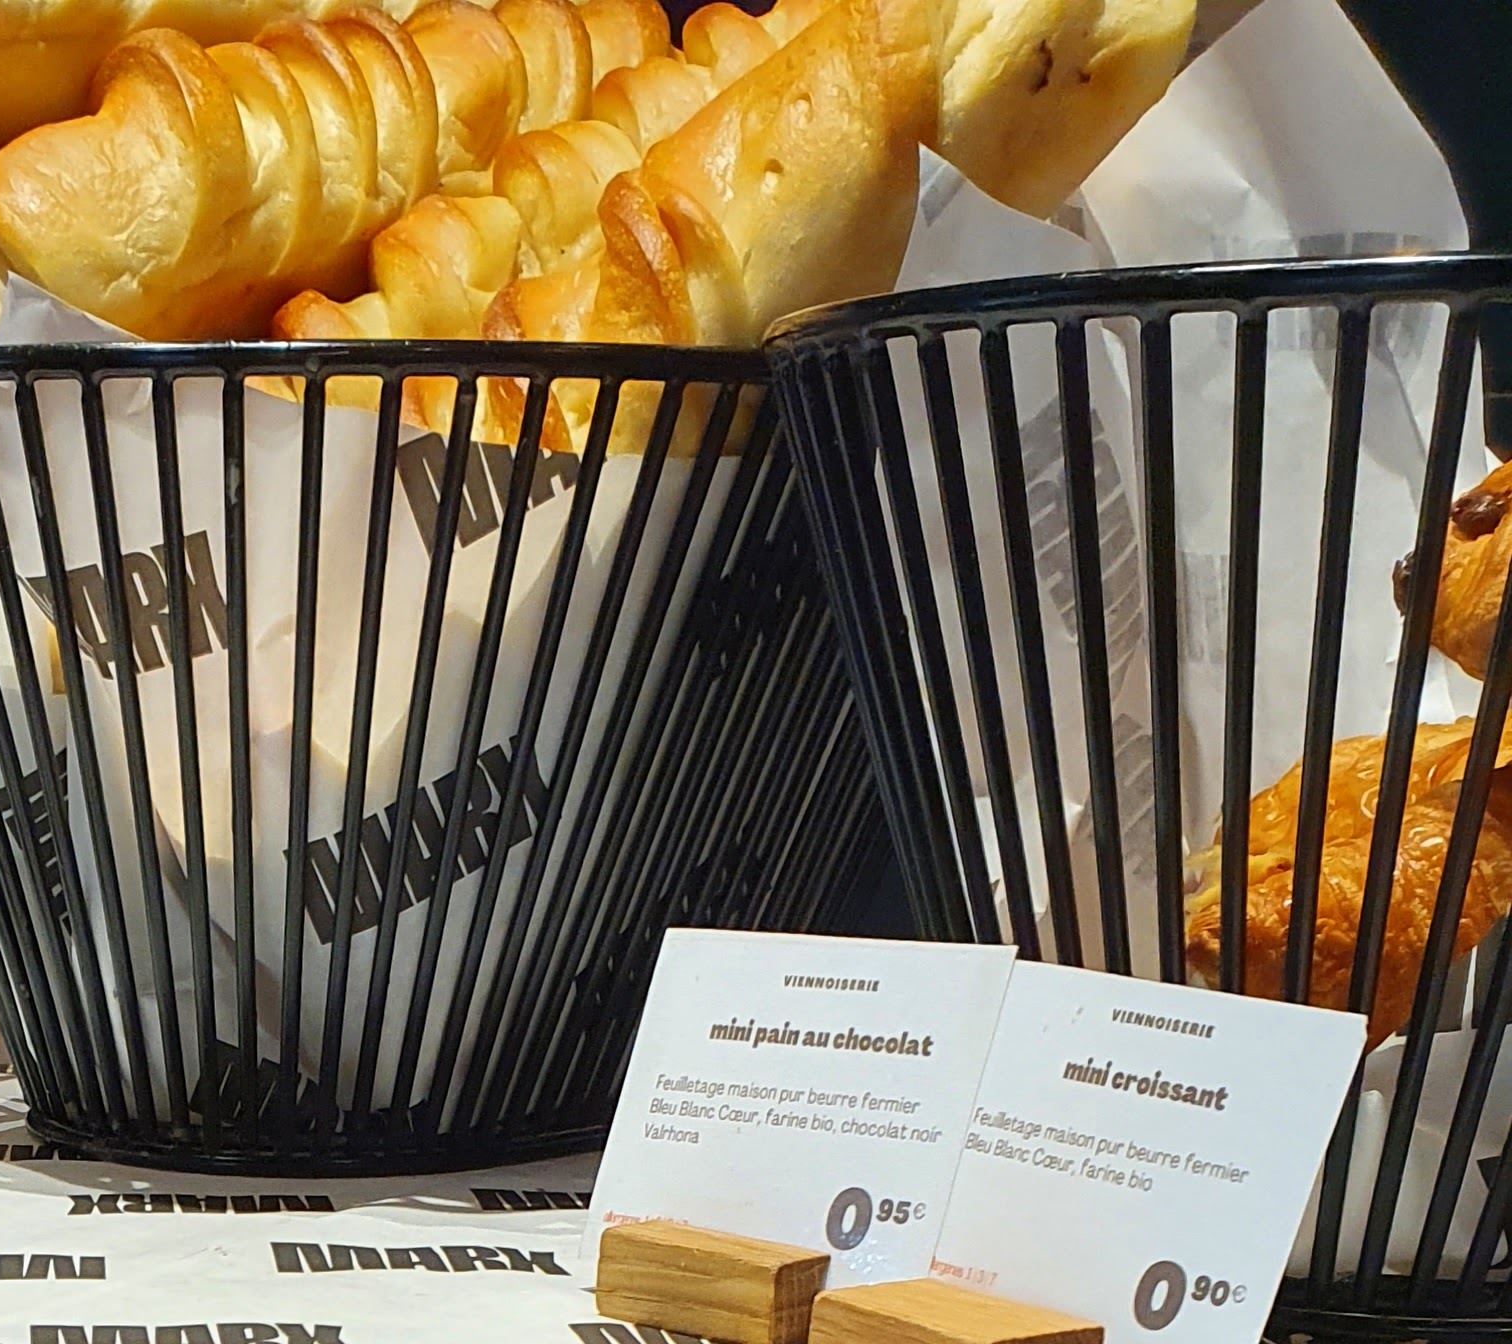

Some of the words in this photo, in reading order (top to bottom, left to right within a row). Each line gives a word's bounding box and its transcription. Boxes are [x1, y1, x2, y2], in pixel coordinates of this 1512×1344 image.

[783, 975, 881, 993] VIENNOISERIE
[709, 1017, 754, 1042] mini
[753, 1020, 801, 1048] pain
[802, 1031, 830, 1048] au
[833, 1027, 935, 1057] chocolat
[1111, 1008, 1216, 1040] VIENNOISERIE
[656, 1073, 726, 1099] Feuilletage
[727, 1082, 777, 1102] maison
[778, 1087, 805, 1107] pur
[807, 1086, 858, 1110] beurre
[861, 1090, 921, 1115] fermier
[1062, 1057, 1111, 1087] mini
[1111, 1069, 1231, 1112] croissant
[643, 1122, 701, 1145] Valrhona
[649, 1097, 677, 1117] Bleu
[678, 1100, 716, 1120] Blanc
[764, 1108, 808, 1131] farine
[841, 1117, 908, 1141] chocolat
[909, 1124, 943, 1145] noir
[964, 1132, 993, 1155] Bleu
[994, 1140, 1031, 1164] Blanc
[1080, 1157, 1126, 1187] farine
[1128, 1169, 1154, 1193] bio
[973, 1107, 1042, 1140] Feuilletage
[1044, 1125, 1096, 1151] maison
[1096, 1138, 1125, 1160] pur
[1127, 1140, 1181, 1170] beurre
[1185, 1153, 1251, 1185] fermier
[270, 1241, 574, 1277] MARX
